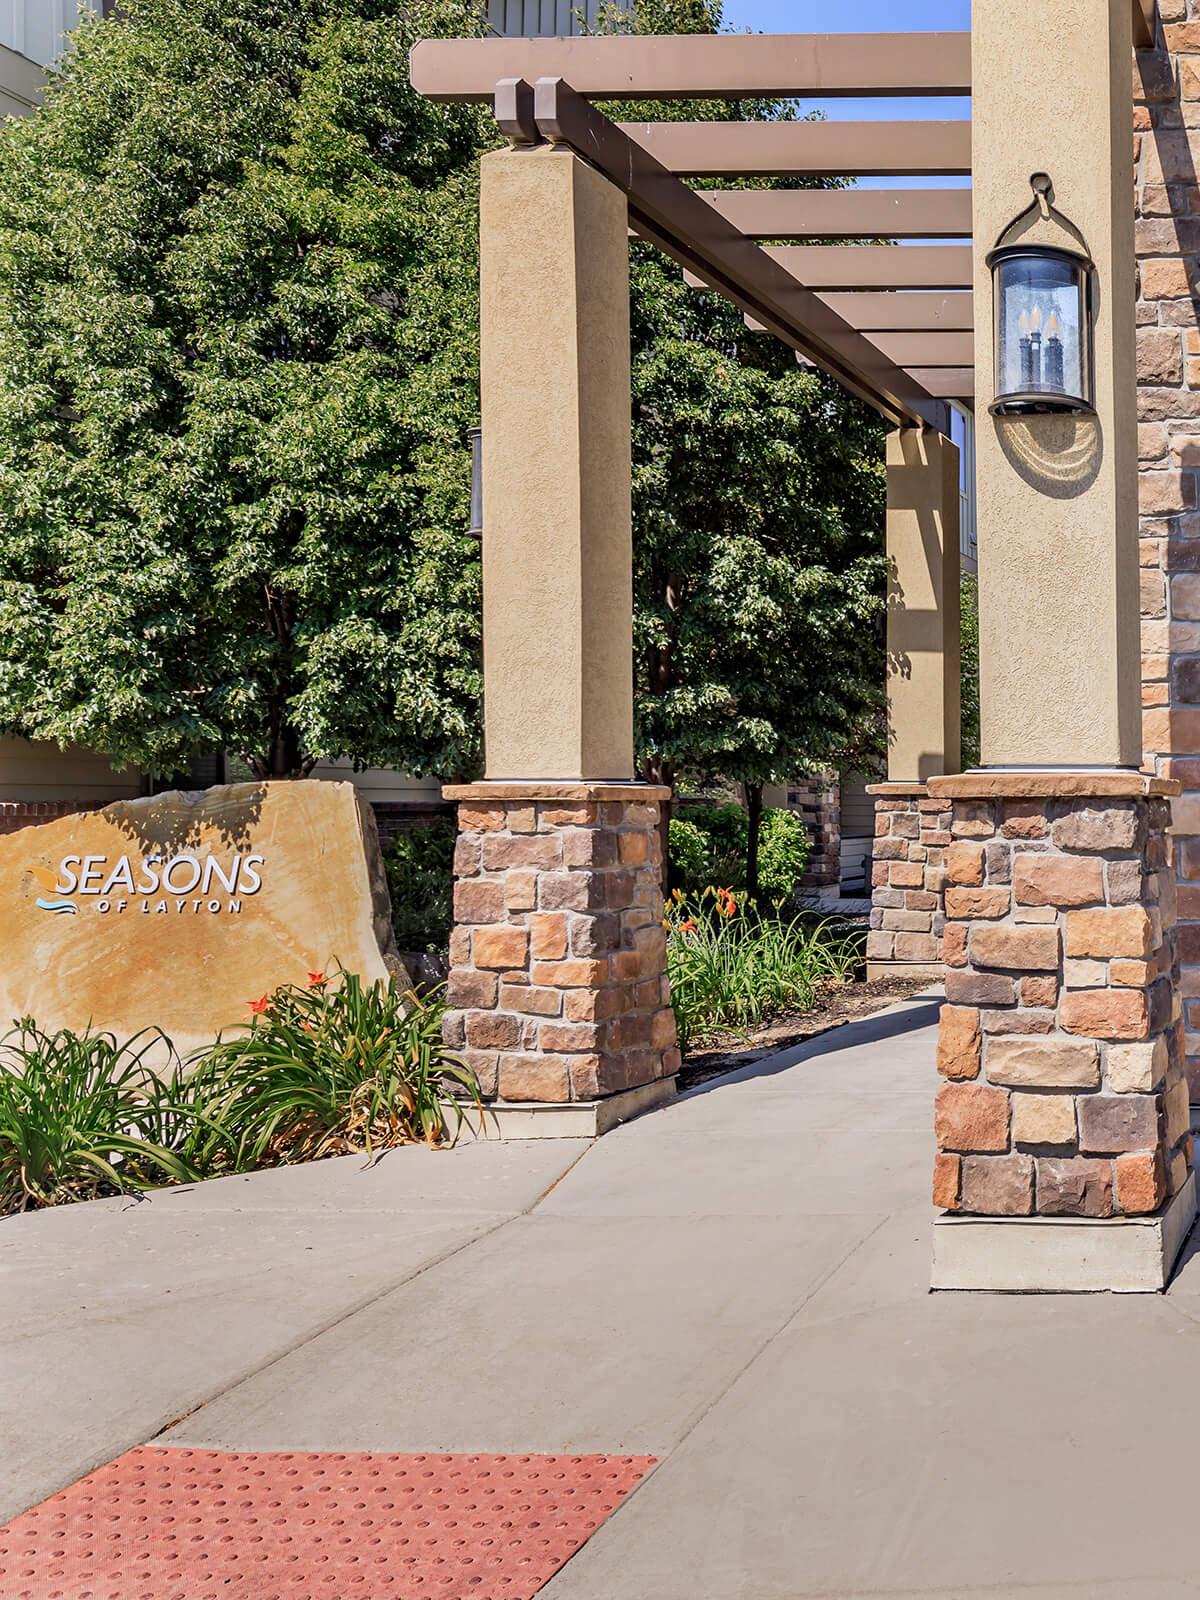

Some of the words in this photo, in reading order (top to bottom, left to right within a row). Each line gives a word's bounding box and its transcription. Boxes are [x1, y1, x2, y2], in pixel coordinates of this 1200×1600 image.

[56, 855, 265, 895] SEASONS
[98, 899, 129, 914] OF
[141, 899, 243, 914] LAYTON
